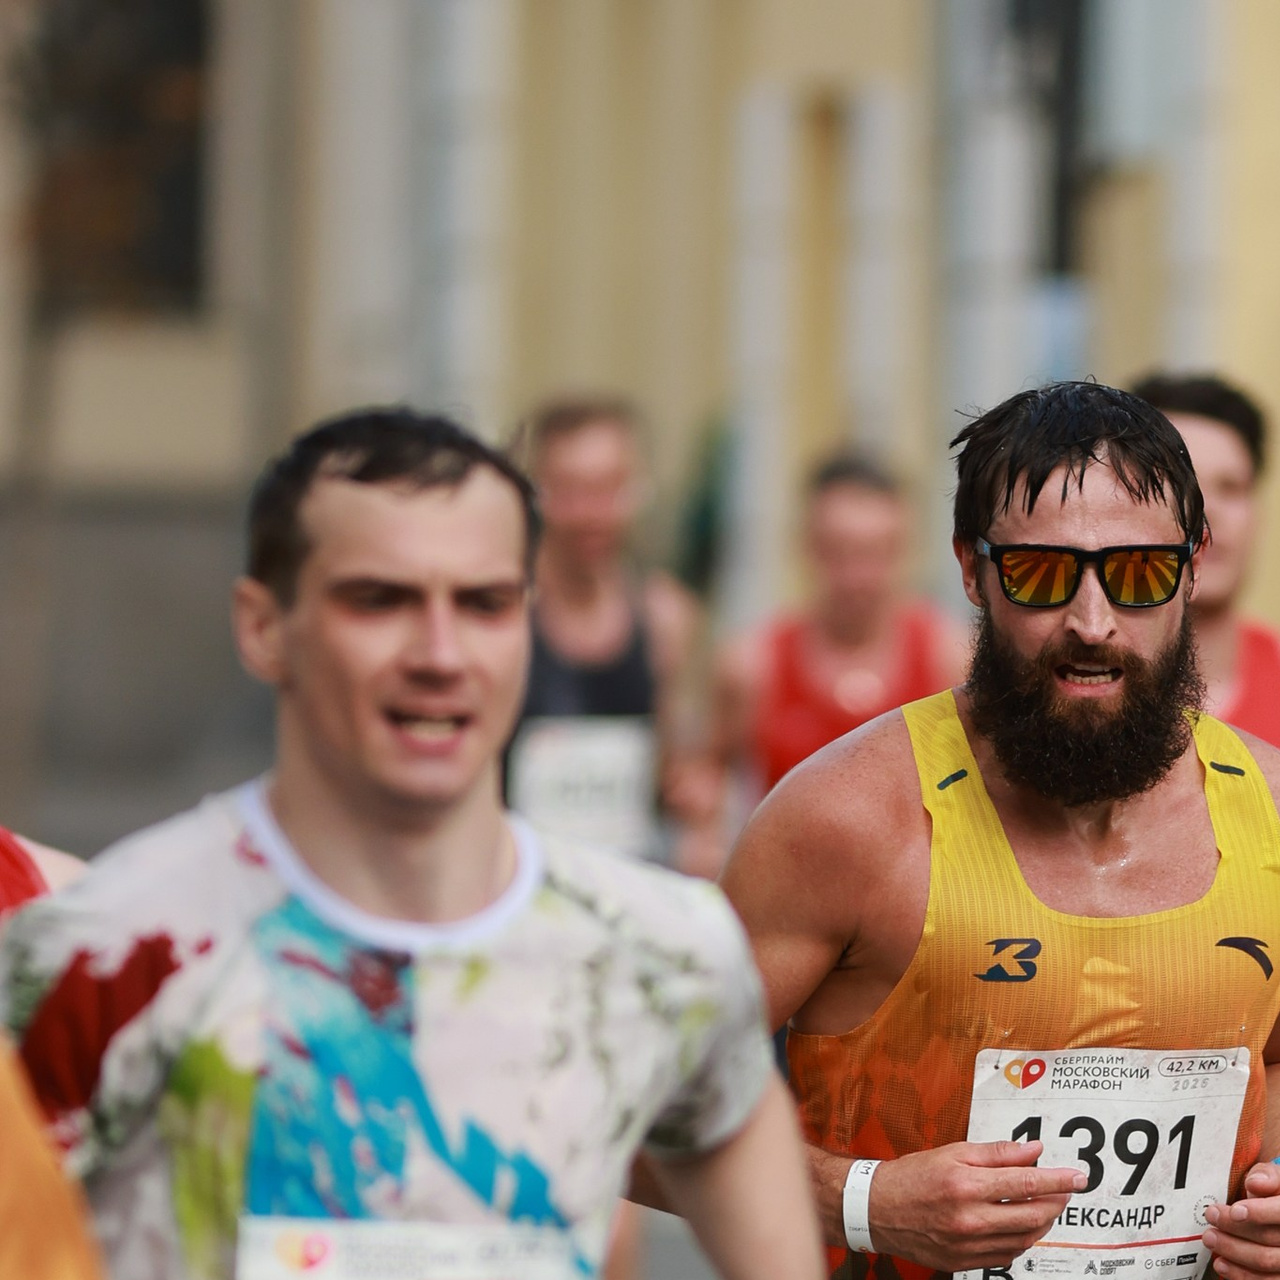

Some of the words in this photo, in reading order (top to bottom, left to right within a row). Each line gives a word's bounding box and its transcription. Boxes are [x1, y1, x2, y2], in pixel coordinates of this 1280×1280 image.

[1054, 1056, 1125, 1065] СБЕРПРАЙМ
[1052, 1066, 1150, 1080] МОСКОВСКИЙ
[1166, 1060, 1193, 1074] 42,2
[1050, 1079, 1123, 1091] МАРАФОН
[1155, 1258, 1176, 1267] СБЕР
